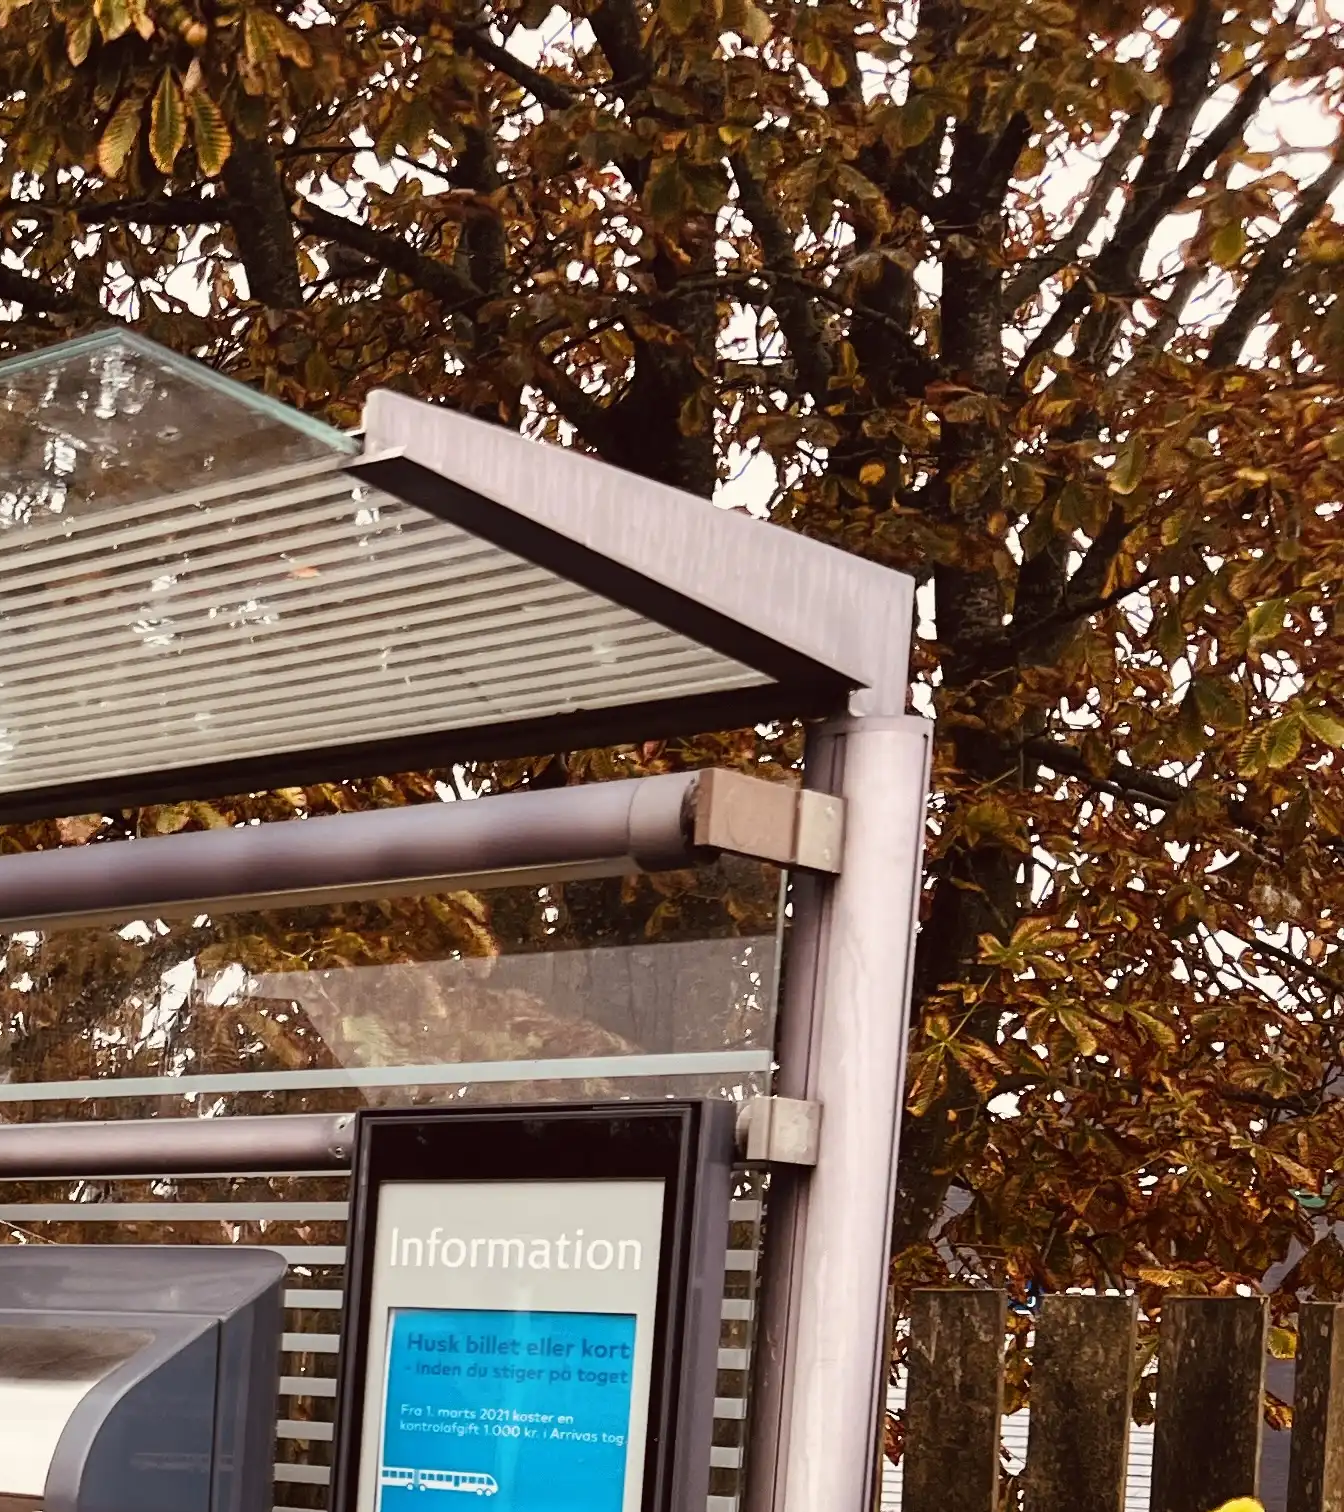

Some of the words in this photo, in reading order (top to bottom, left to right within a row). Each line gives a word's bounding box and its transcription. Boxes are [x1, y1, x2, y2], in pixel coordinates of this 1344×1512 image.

[389, 1226, 643, 1271] Information
[407, 1332, 460, 1353] Husk
[465, 1334, 520, 1355] billet
[526, 1337, 575, 1357] eller
[581, 1338, 630, 1359] kort
[416, 1361, 461, 1376] inden
[466, 1362, 488, 1378] du
[493, 1364, 545, 1383] stiger
[549, 1366, 571, 1385] på
[578, 1368, 628, 1386] toget
[401, 1404, 422, 1416] Fra
[426, 1405, 434, 1417] 1.
[437, 1408, 476, 1419] marts
[479, 1408, 510, 1421] 2021
[513, 1408, 554, 1423] koster
[557, 1415, 574, 1424] en
[400, 1420, 479, 1436] kontrolafgift
[550, 1428, 598, 1443] Arrivas
